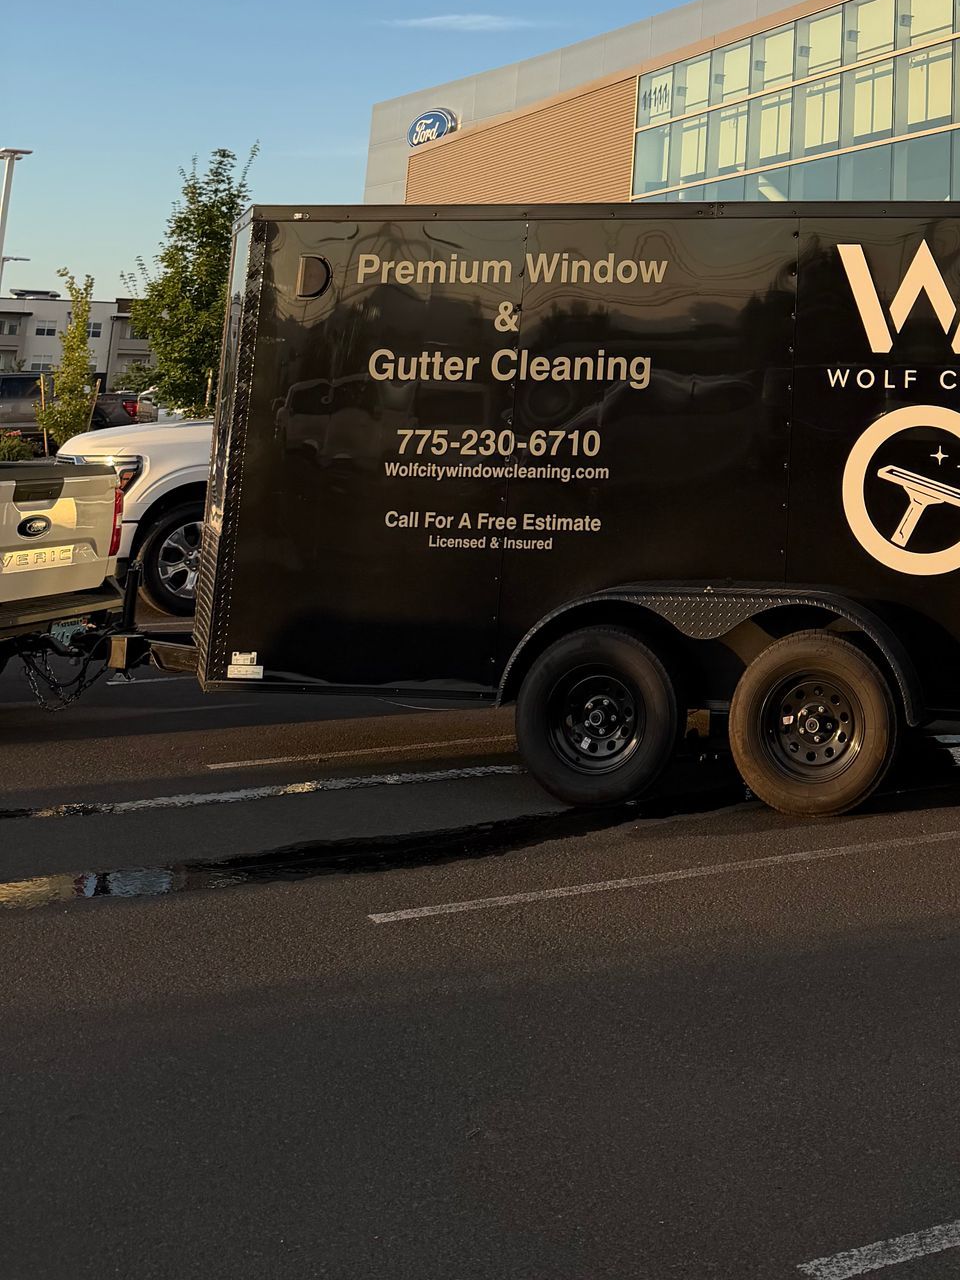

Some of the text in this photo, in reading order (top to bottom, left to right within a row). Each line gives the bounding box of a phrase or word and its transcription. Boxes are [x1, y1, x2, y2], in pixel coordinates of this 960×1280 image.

[412, 118, 440, 145] Ford
[357, 252, 669, 284] Premium Window
[494, 300, 519, 332] &
[368, 348, 652, 389] Gutter Cleaning
[827, 368, 917, 389] WOLF
[396, 429, 601, 457] 775-230-6710
[384, 462, 610, 483] Wolfcitywindowcleaning.com
[385, 511, 602, 532] Call For A Free Estimate
[428, 534, 553, 551] Licensed & Insured
